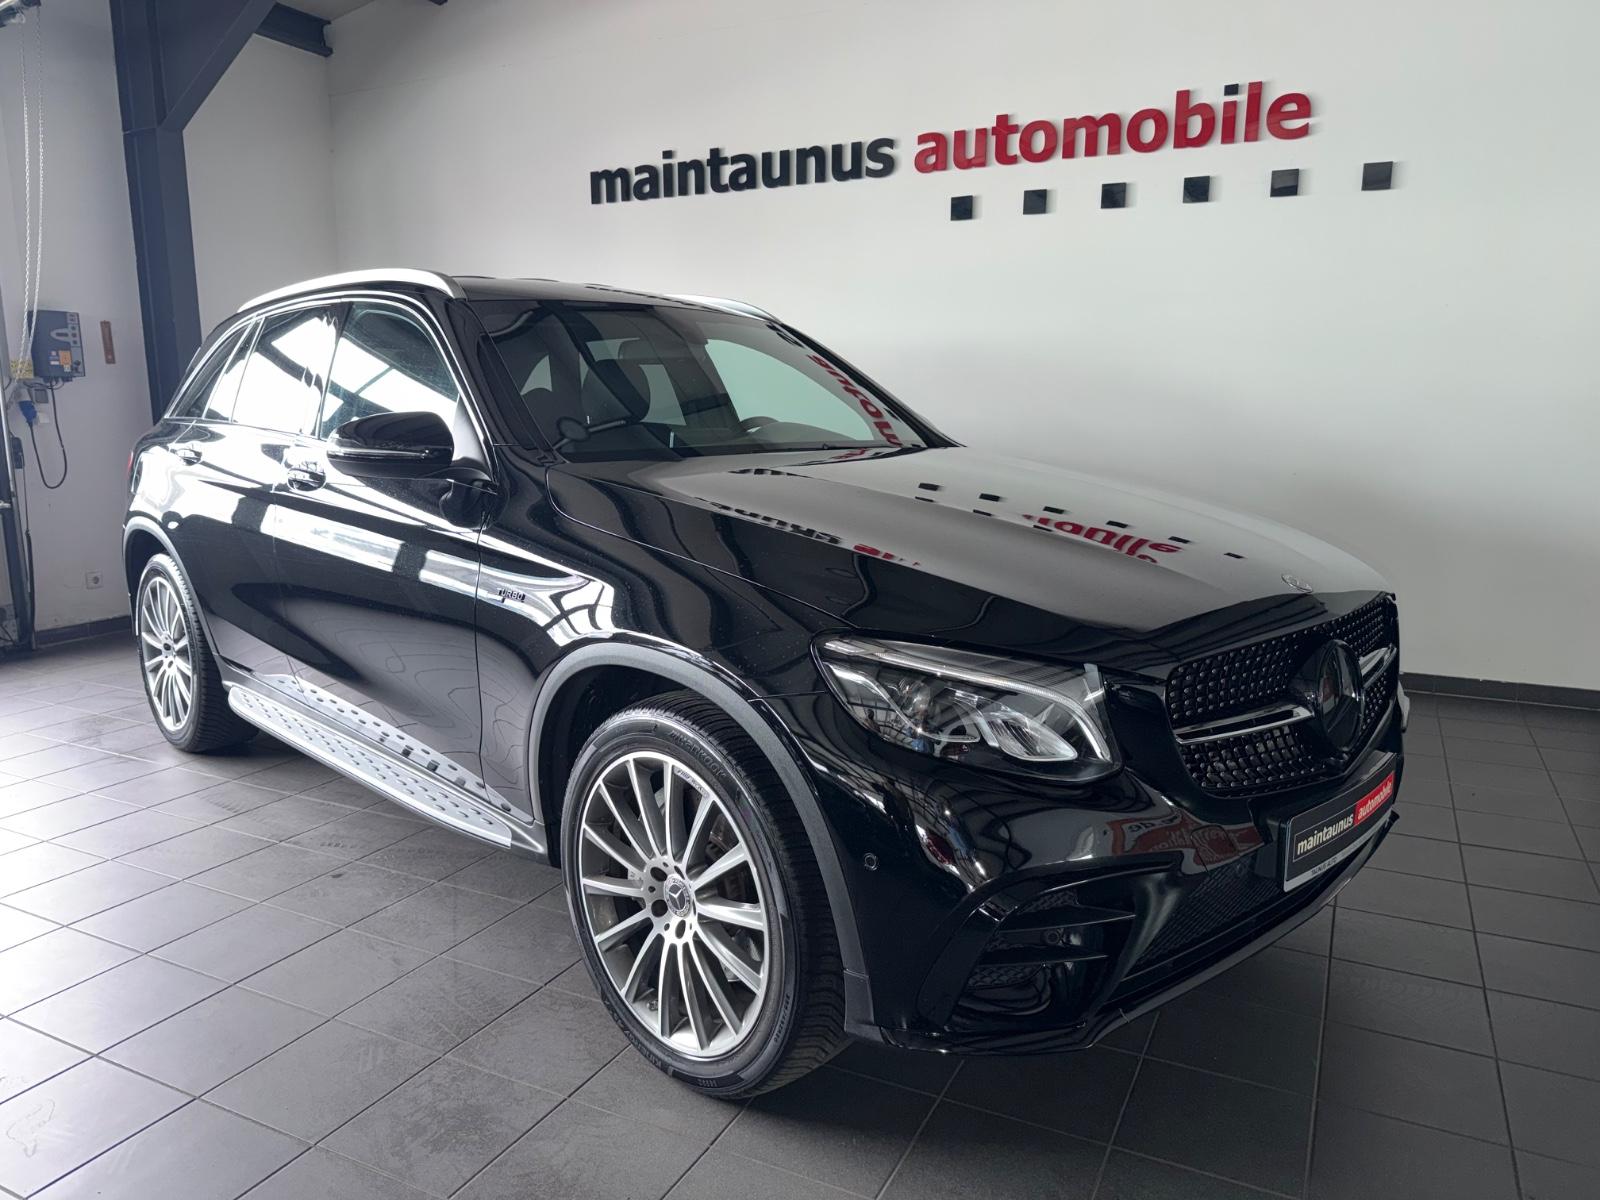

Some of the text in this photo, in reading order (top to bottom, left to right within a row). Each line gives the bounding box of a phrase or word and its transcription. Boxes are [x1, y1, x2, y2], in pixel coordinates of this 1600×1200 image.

[590, 81, 1311, 205] maintaunus automobile
[497, 587, 524, 601] TURBO
[1297, 780, 1392, 855] maintaunus automobile
